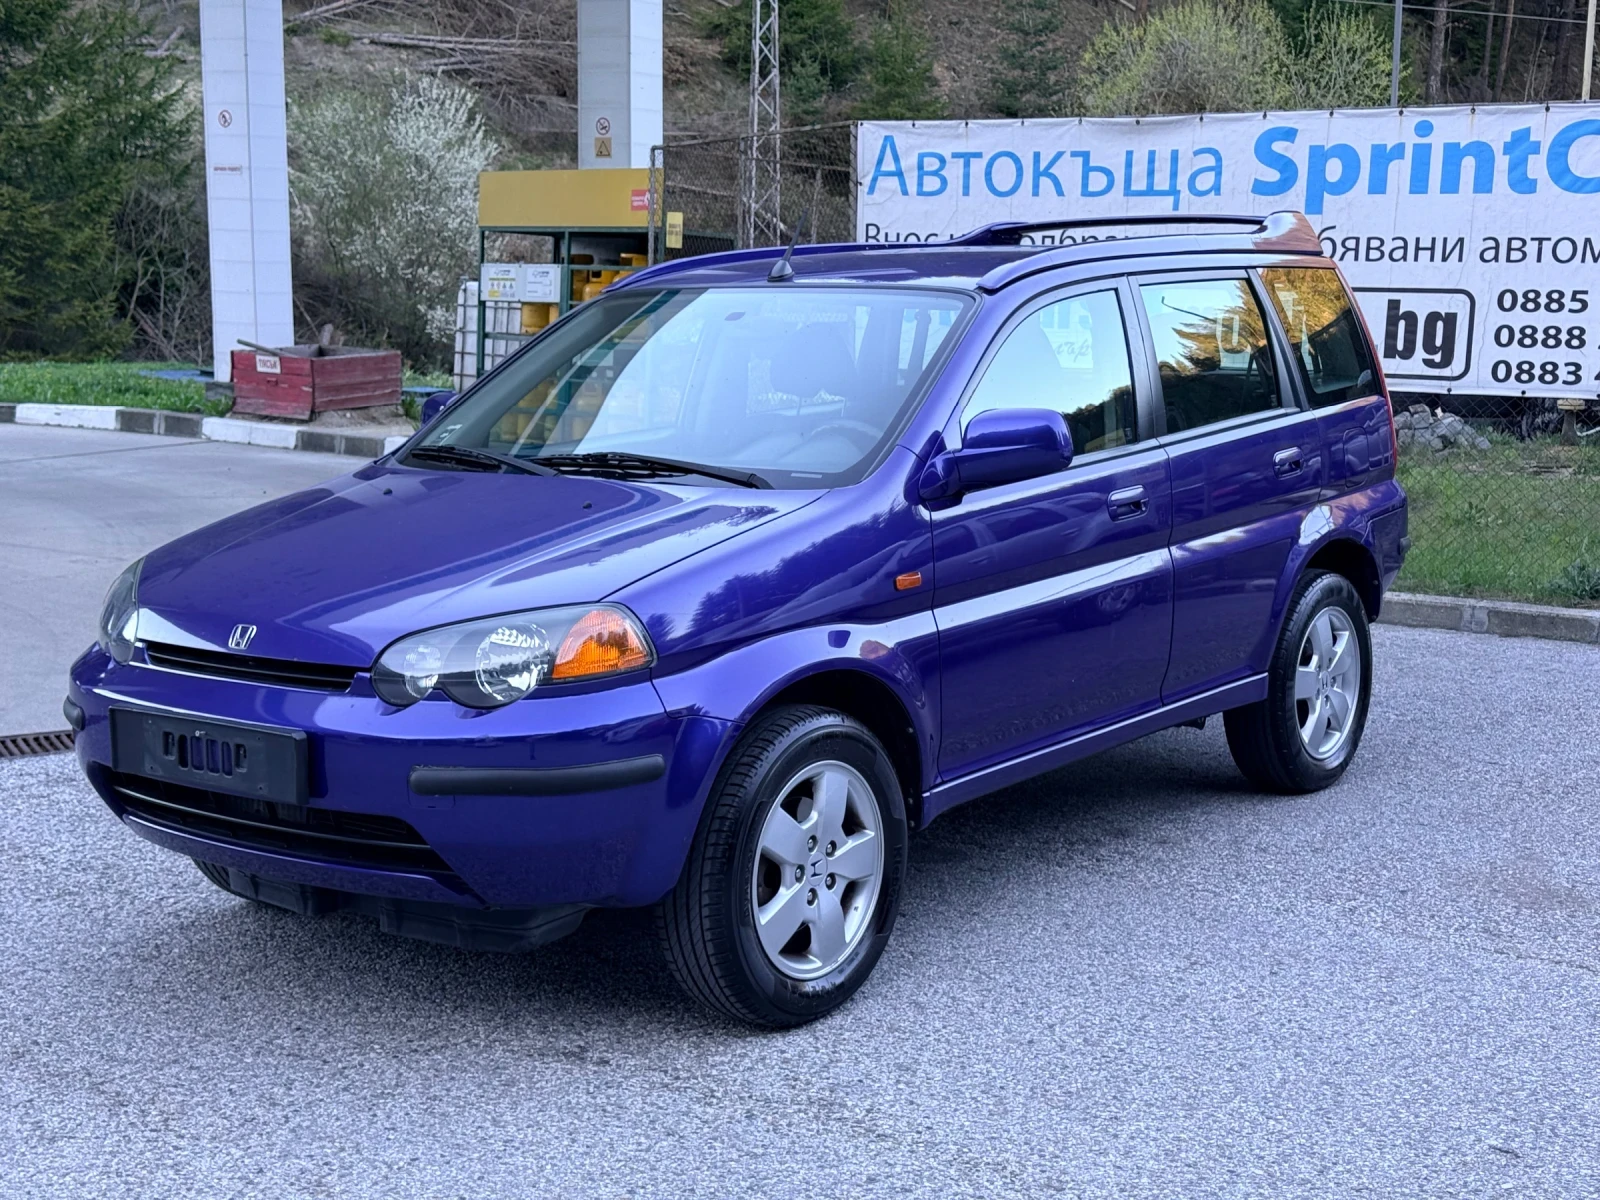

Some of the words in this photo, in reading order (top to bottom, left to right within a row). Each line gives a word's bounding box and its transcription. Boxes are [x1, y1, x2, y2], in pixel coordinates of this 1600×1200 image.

[866, 134, 1224, 212] Автокъща
[1250, 119, 1600, 216] SprintC
[1318, 225, 1465, 263] бявани
[1496, 288, 1589, 314] 0885
[1493, 324, 1587, 350] 0888
[1490, 360, 1583, 386] 0883
